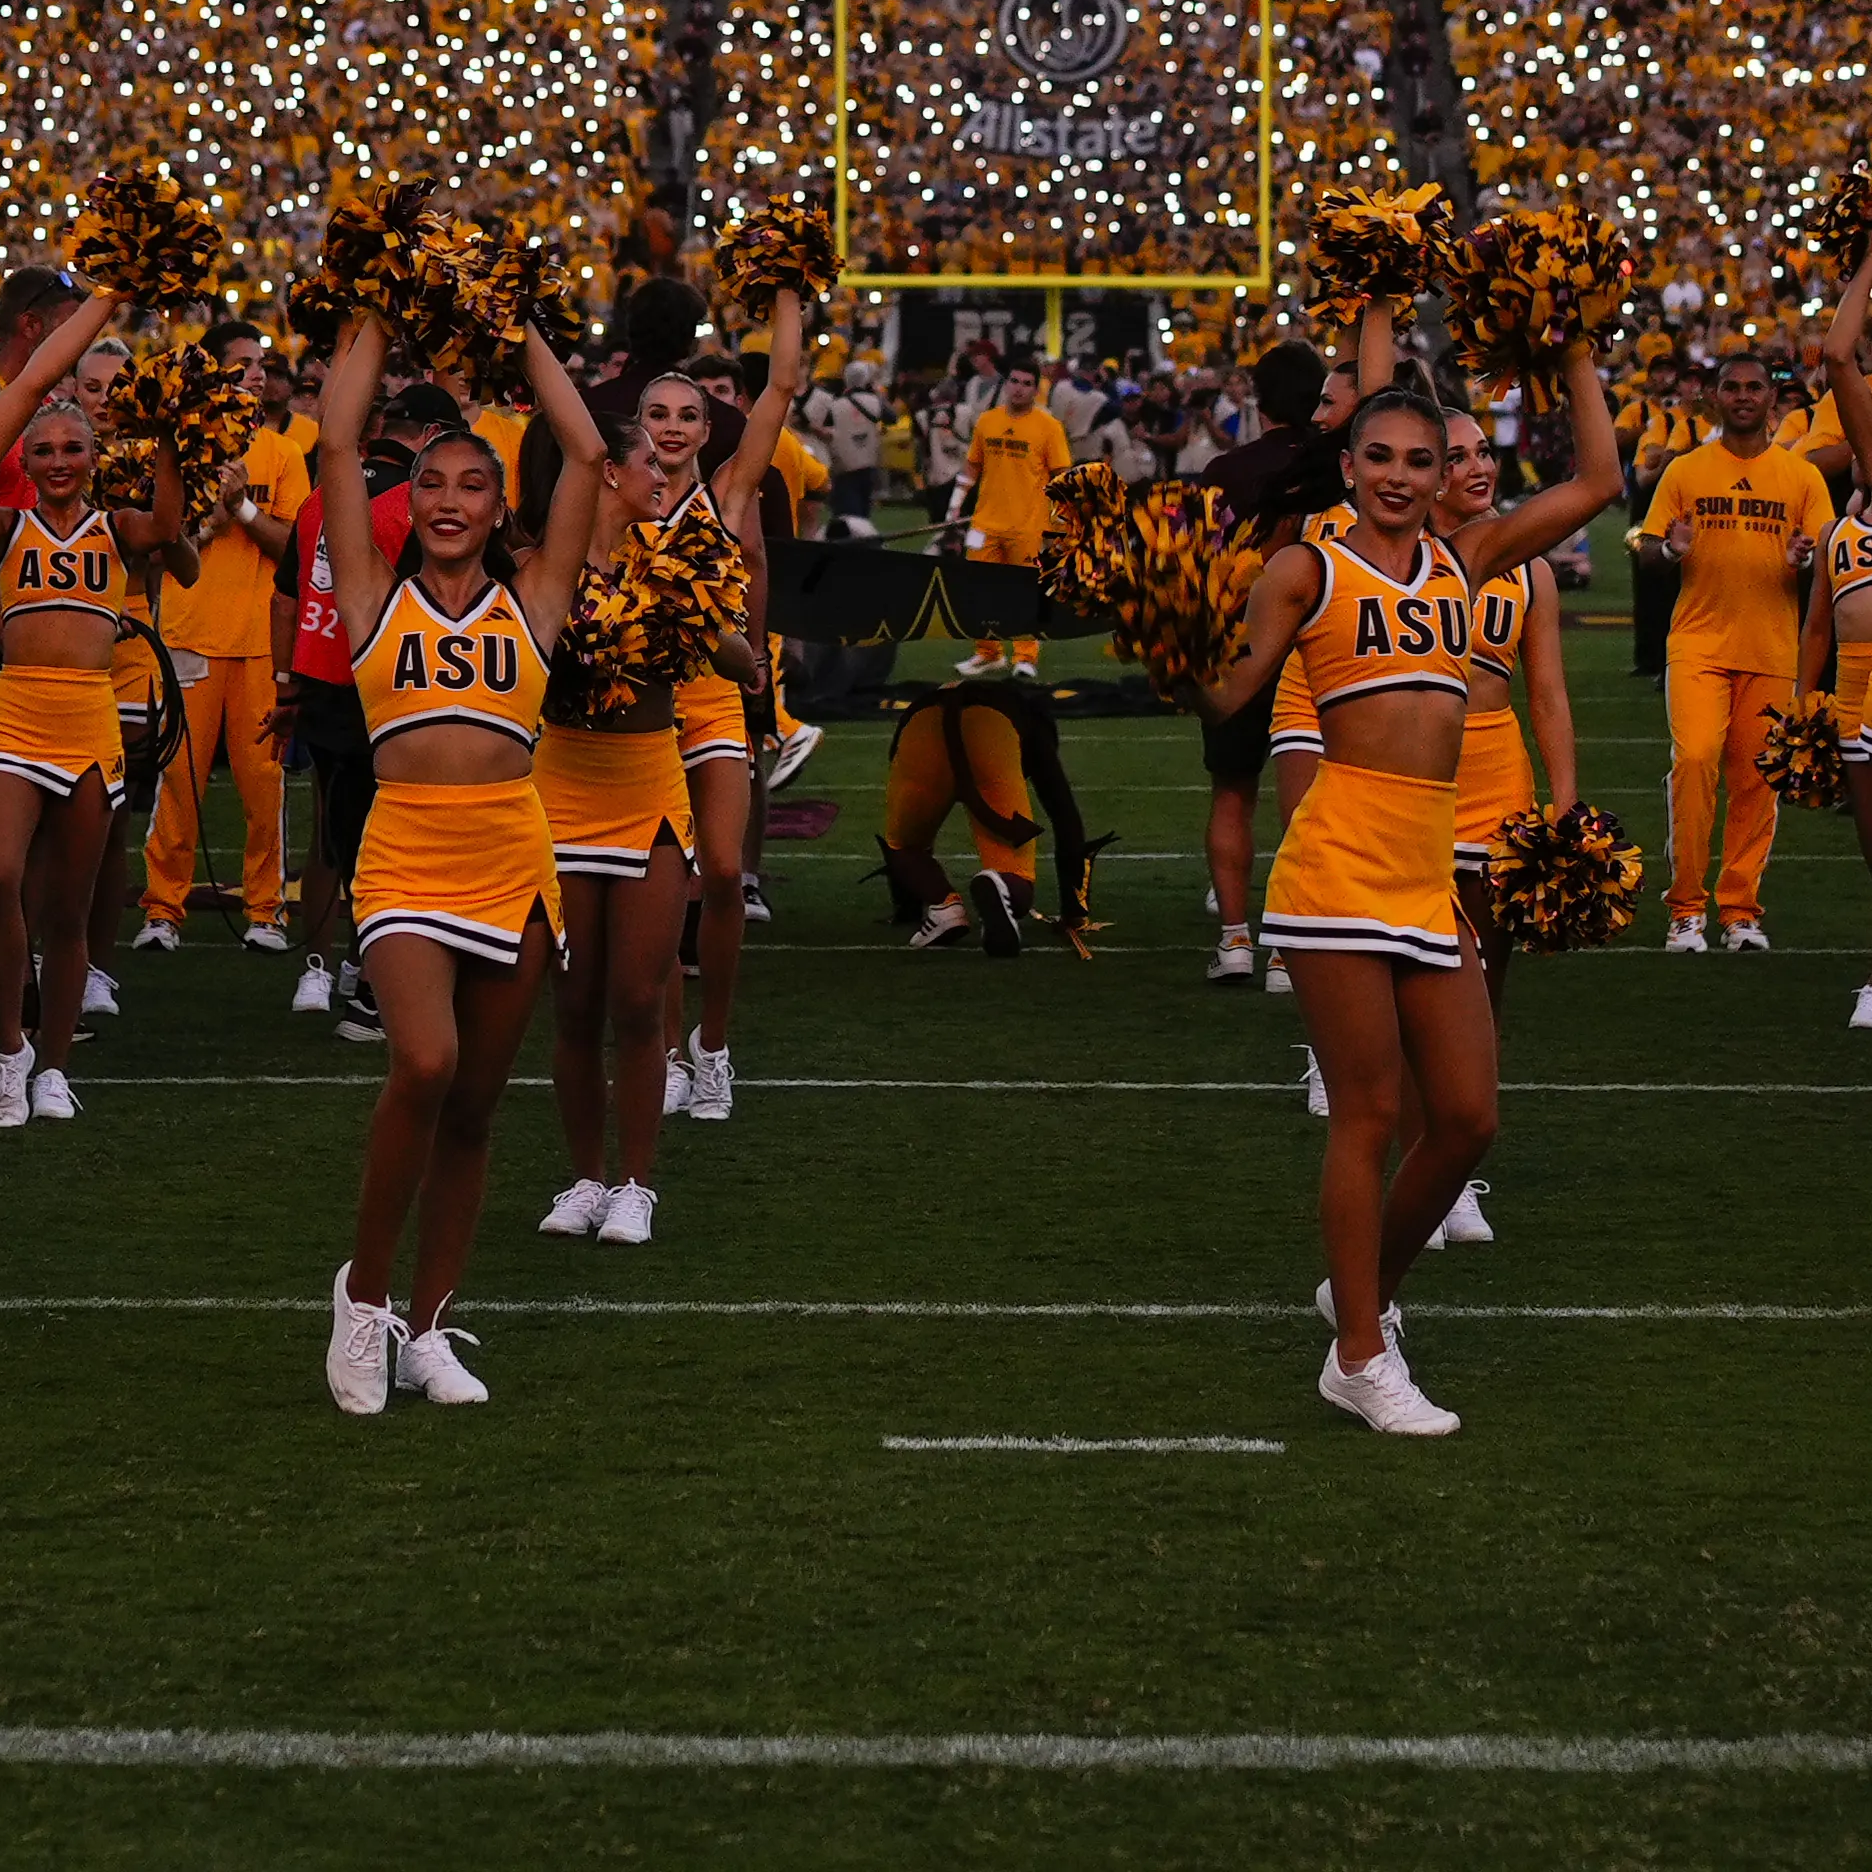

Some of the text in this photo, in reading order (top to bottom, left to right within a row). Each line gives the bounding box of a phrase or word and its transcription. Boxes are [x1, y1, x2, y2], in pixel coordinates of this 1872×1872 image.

[957, 99, 1160, 160] Allstate
[1695, 496, 1788, 522] SUN DEVIL
[16, 546, 112, 595] ASU
[300, 600, 339, 640] 32
[1353, 595, 1470, 658] ASU
[391, 631, 519, 695] ASU
